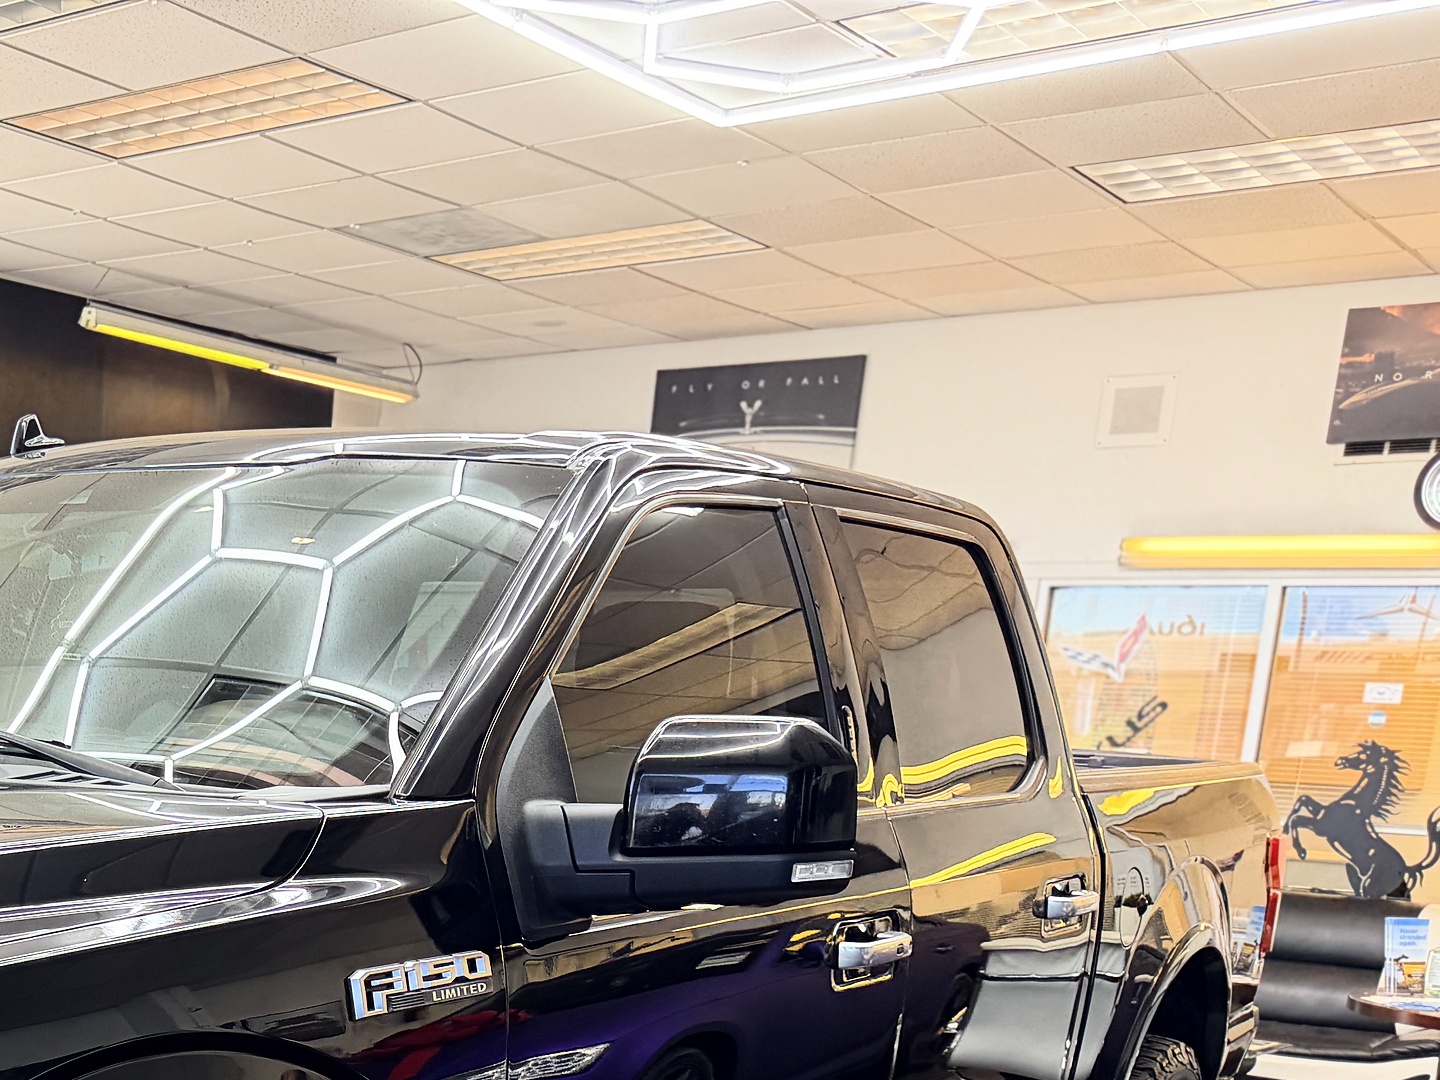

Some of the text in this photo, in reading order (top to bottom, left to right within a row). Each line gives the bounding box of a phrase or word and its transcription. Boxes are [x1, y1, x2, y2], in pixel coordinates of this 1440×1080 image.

[671, 374, 840, 394] FLY OR FALL
[1374, 372, 1403, 382] NO
[431, 982, 488, 1002] LIMITED
